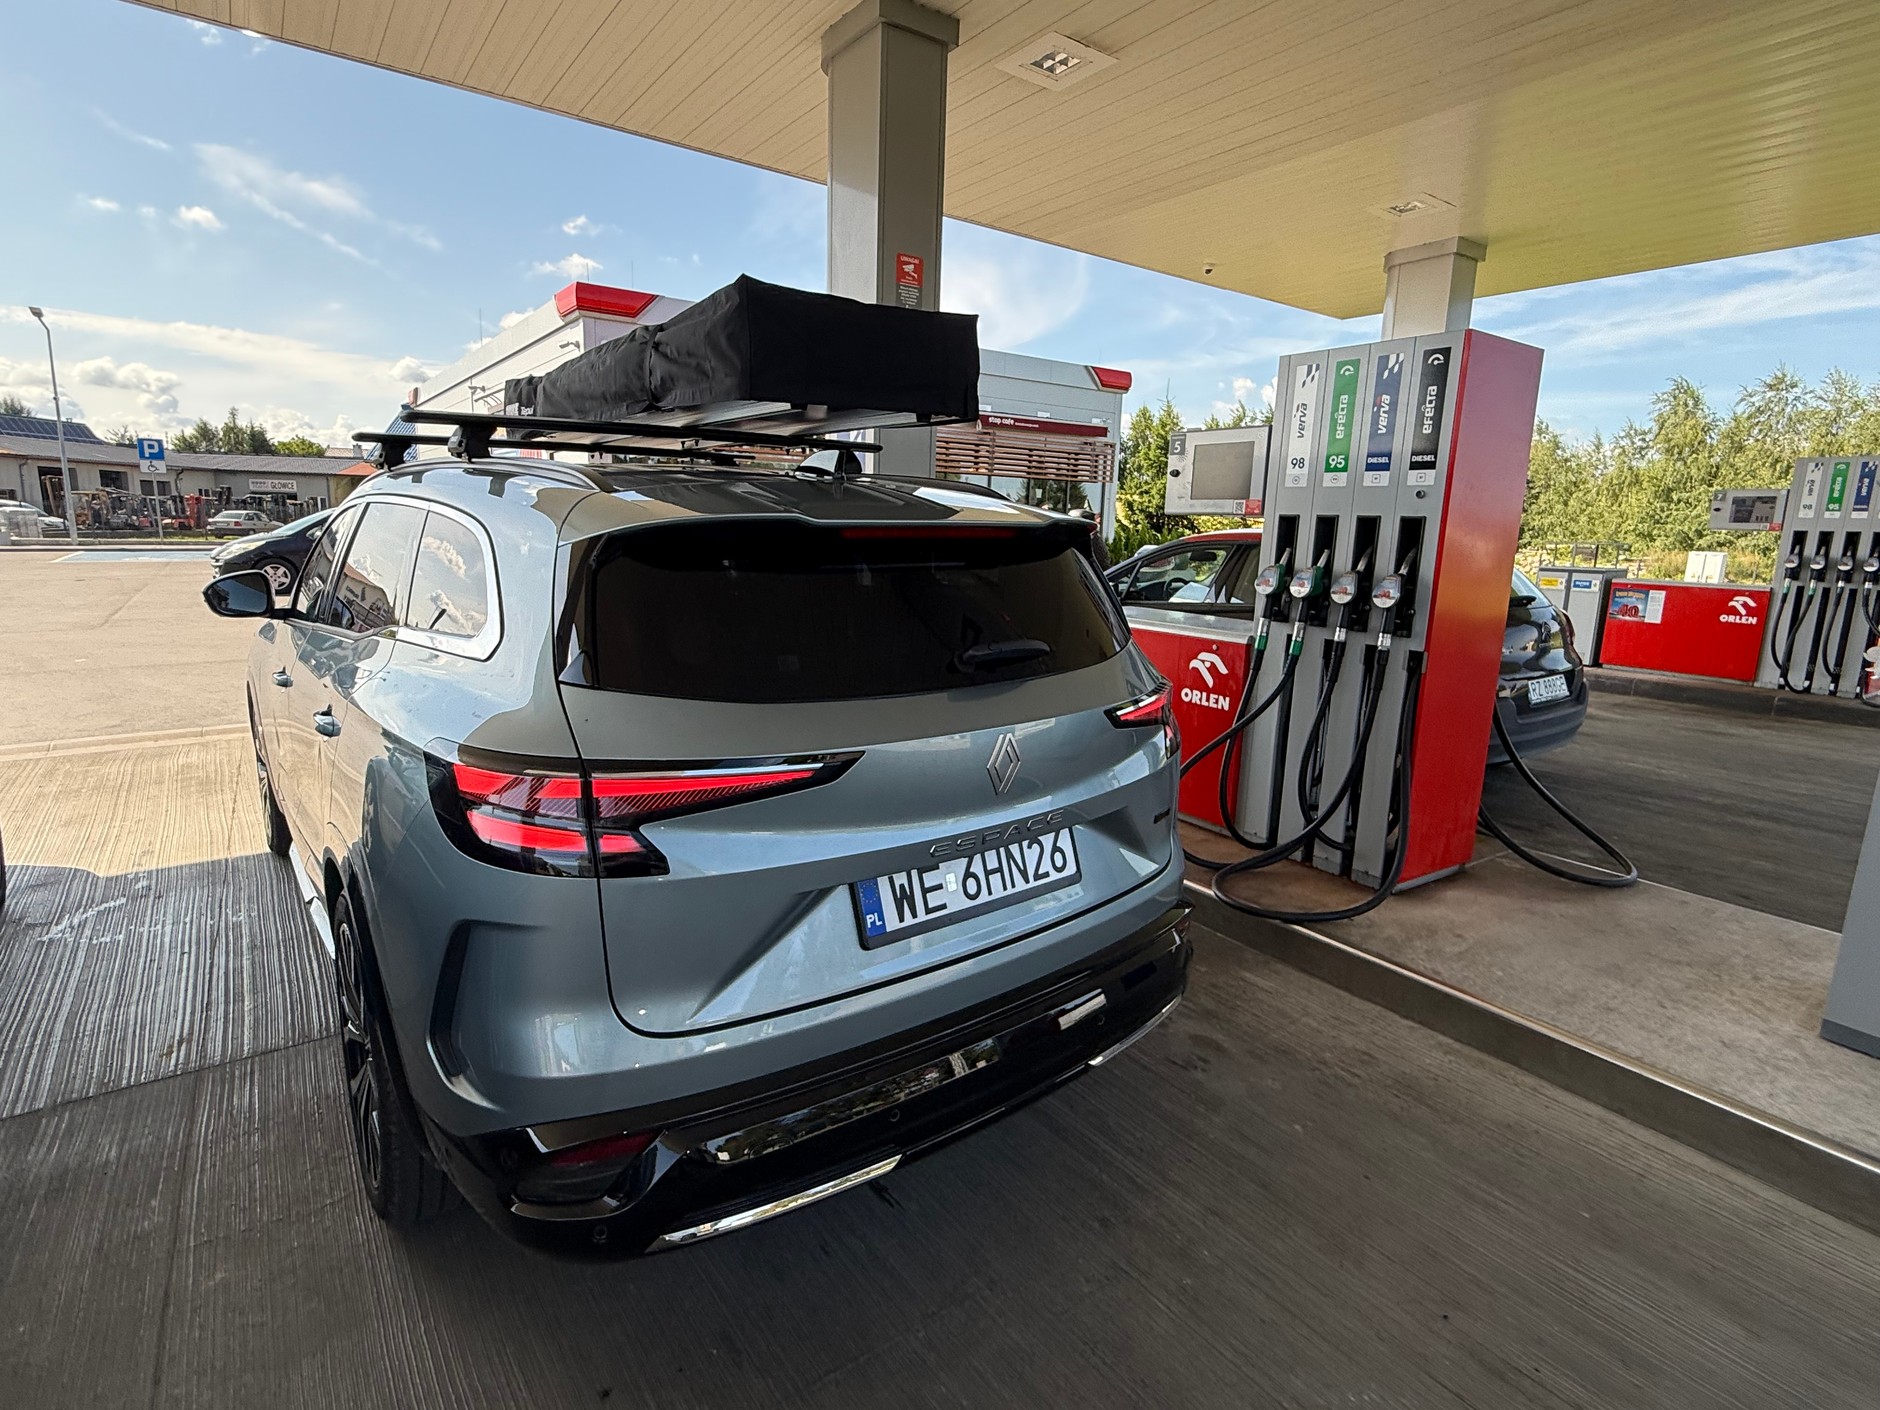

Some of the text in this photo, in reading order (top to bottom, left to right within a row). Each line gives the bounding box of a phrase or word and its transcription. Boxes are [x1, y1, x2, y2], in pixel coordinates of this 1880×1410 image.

[1296, 402, 1308, 438] verva
[1335, 394, 1349, 439] efecta
[1377, 394, 1391, 434] verva
[1422, 385, 1438, 434] efecta
[143, 440, 159, 458] P
[1173, 441, 1181, 453] 5
[1290, 457, 1306, 469] 98
[1328, 455, 1346, 468] 95
[1411, 454, 1436, 462] DIESEL
[1719, 614, 1757, 625] ORLEN
[1181, 687, 1230, 711] ORLEN
[930, 810, 1064, 857] ESPACE
[888, 829, 1067, 923] WE 6HN26
[866, 912, 883, 928] PL
